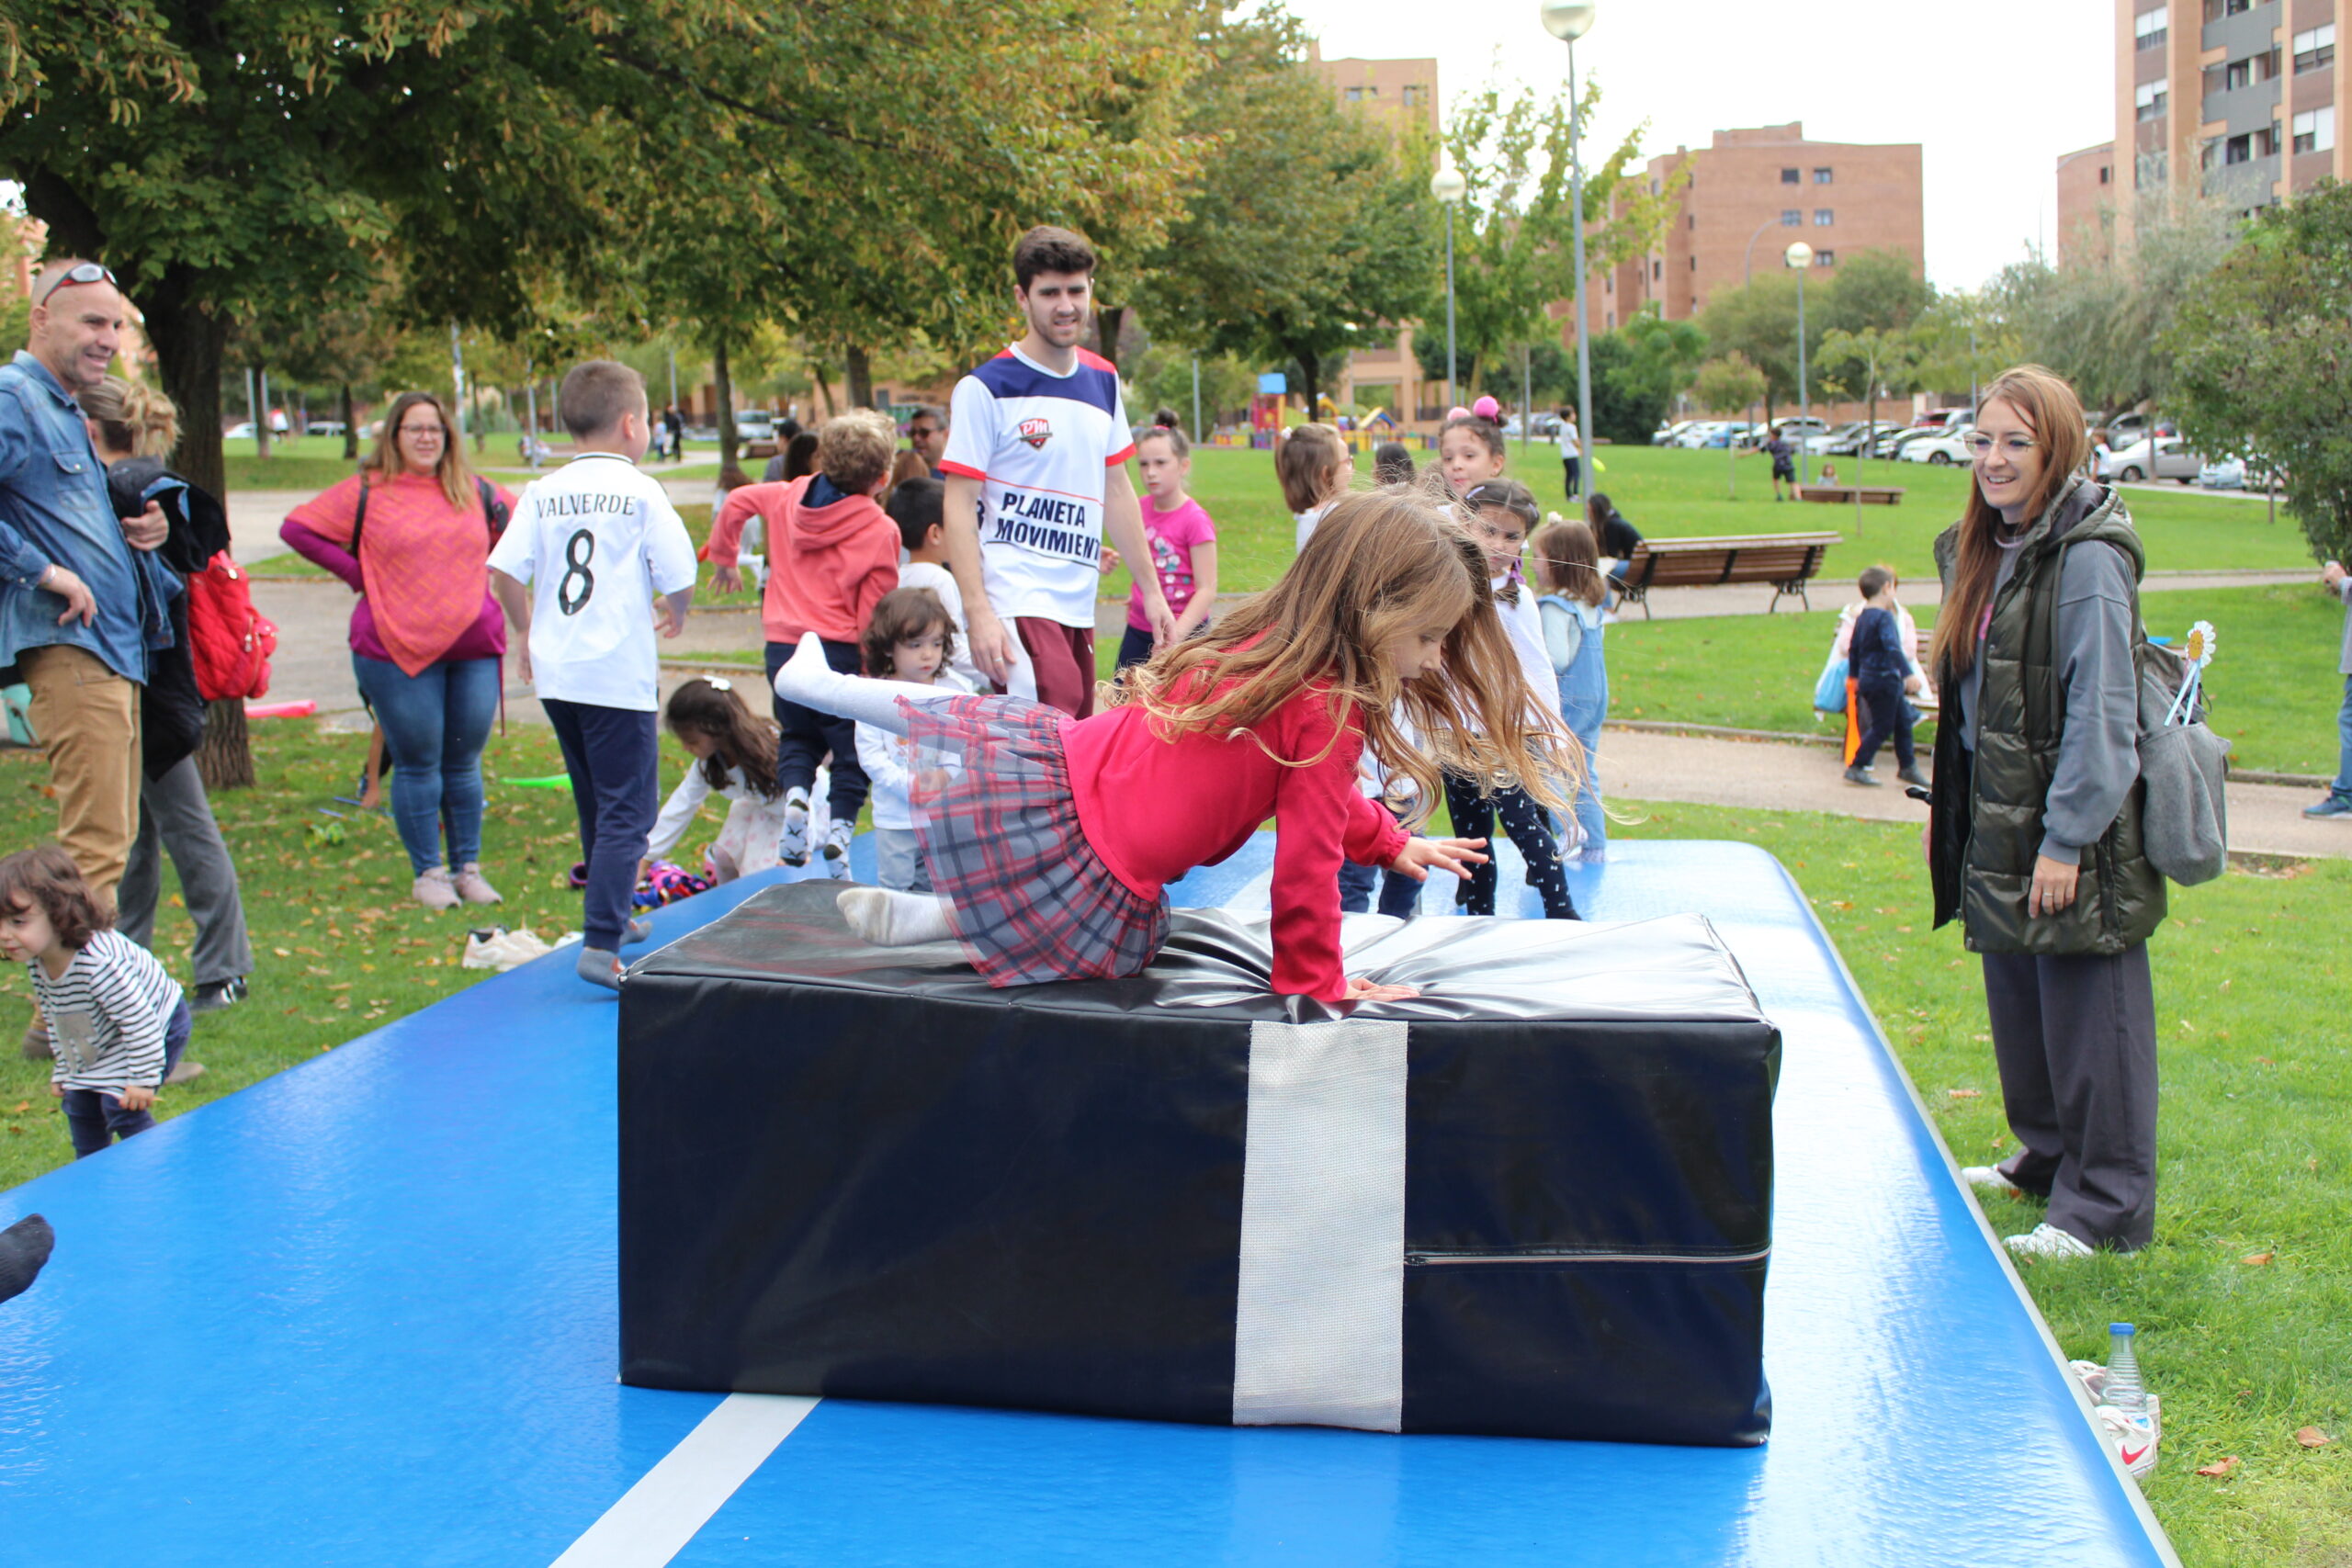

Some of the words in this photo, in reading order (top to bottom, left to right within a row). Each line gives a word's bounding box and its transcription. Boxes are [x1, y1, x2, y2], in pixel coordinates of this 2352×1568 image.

[537, 493, 636, 519] VALVERDE
[1001, 491, 1085, 528] PLANETA
[559, 528, 594, 616] 8
